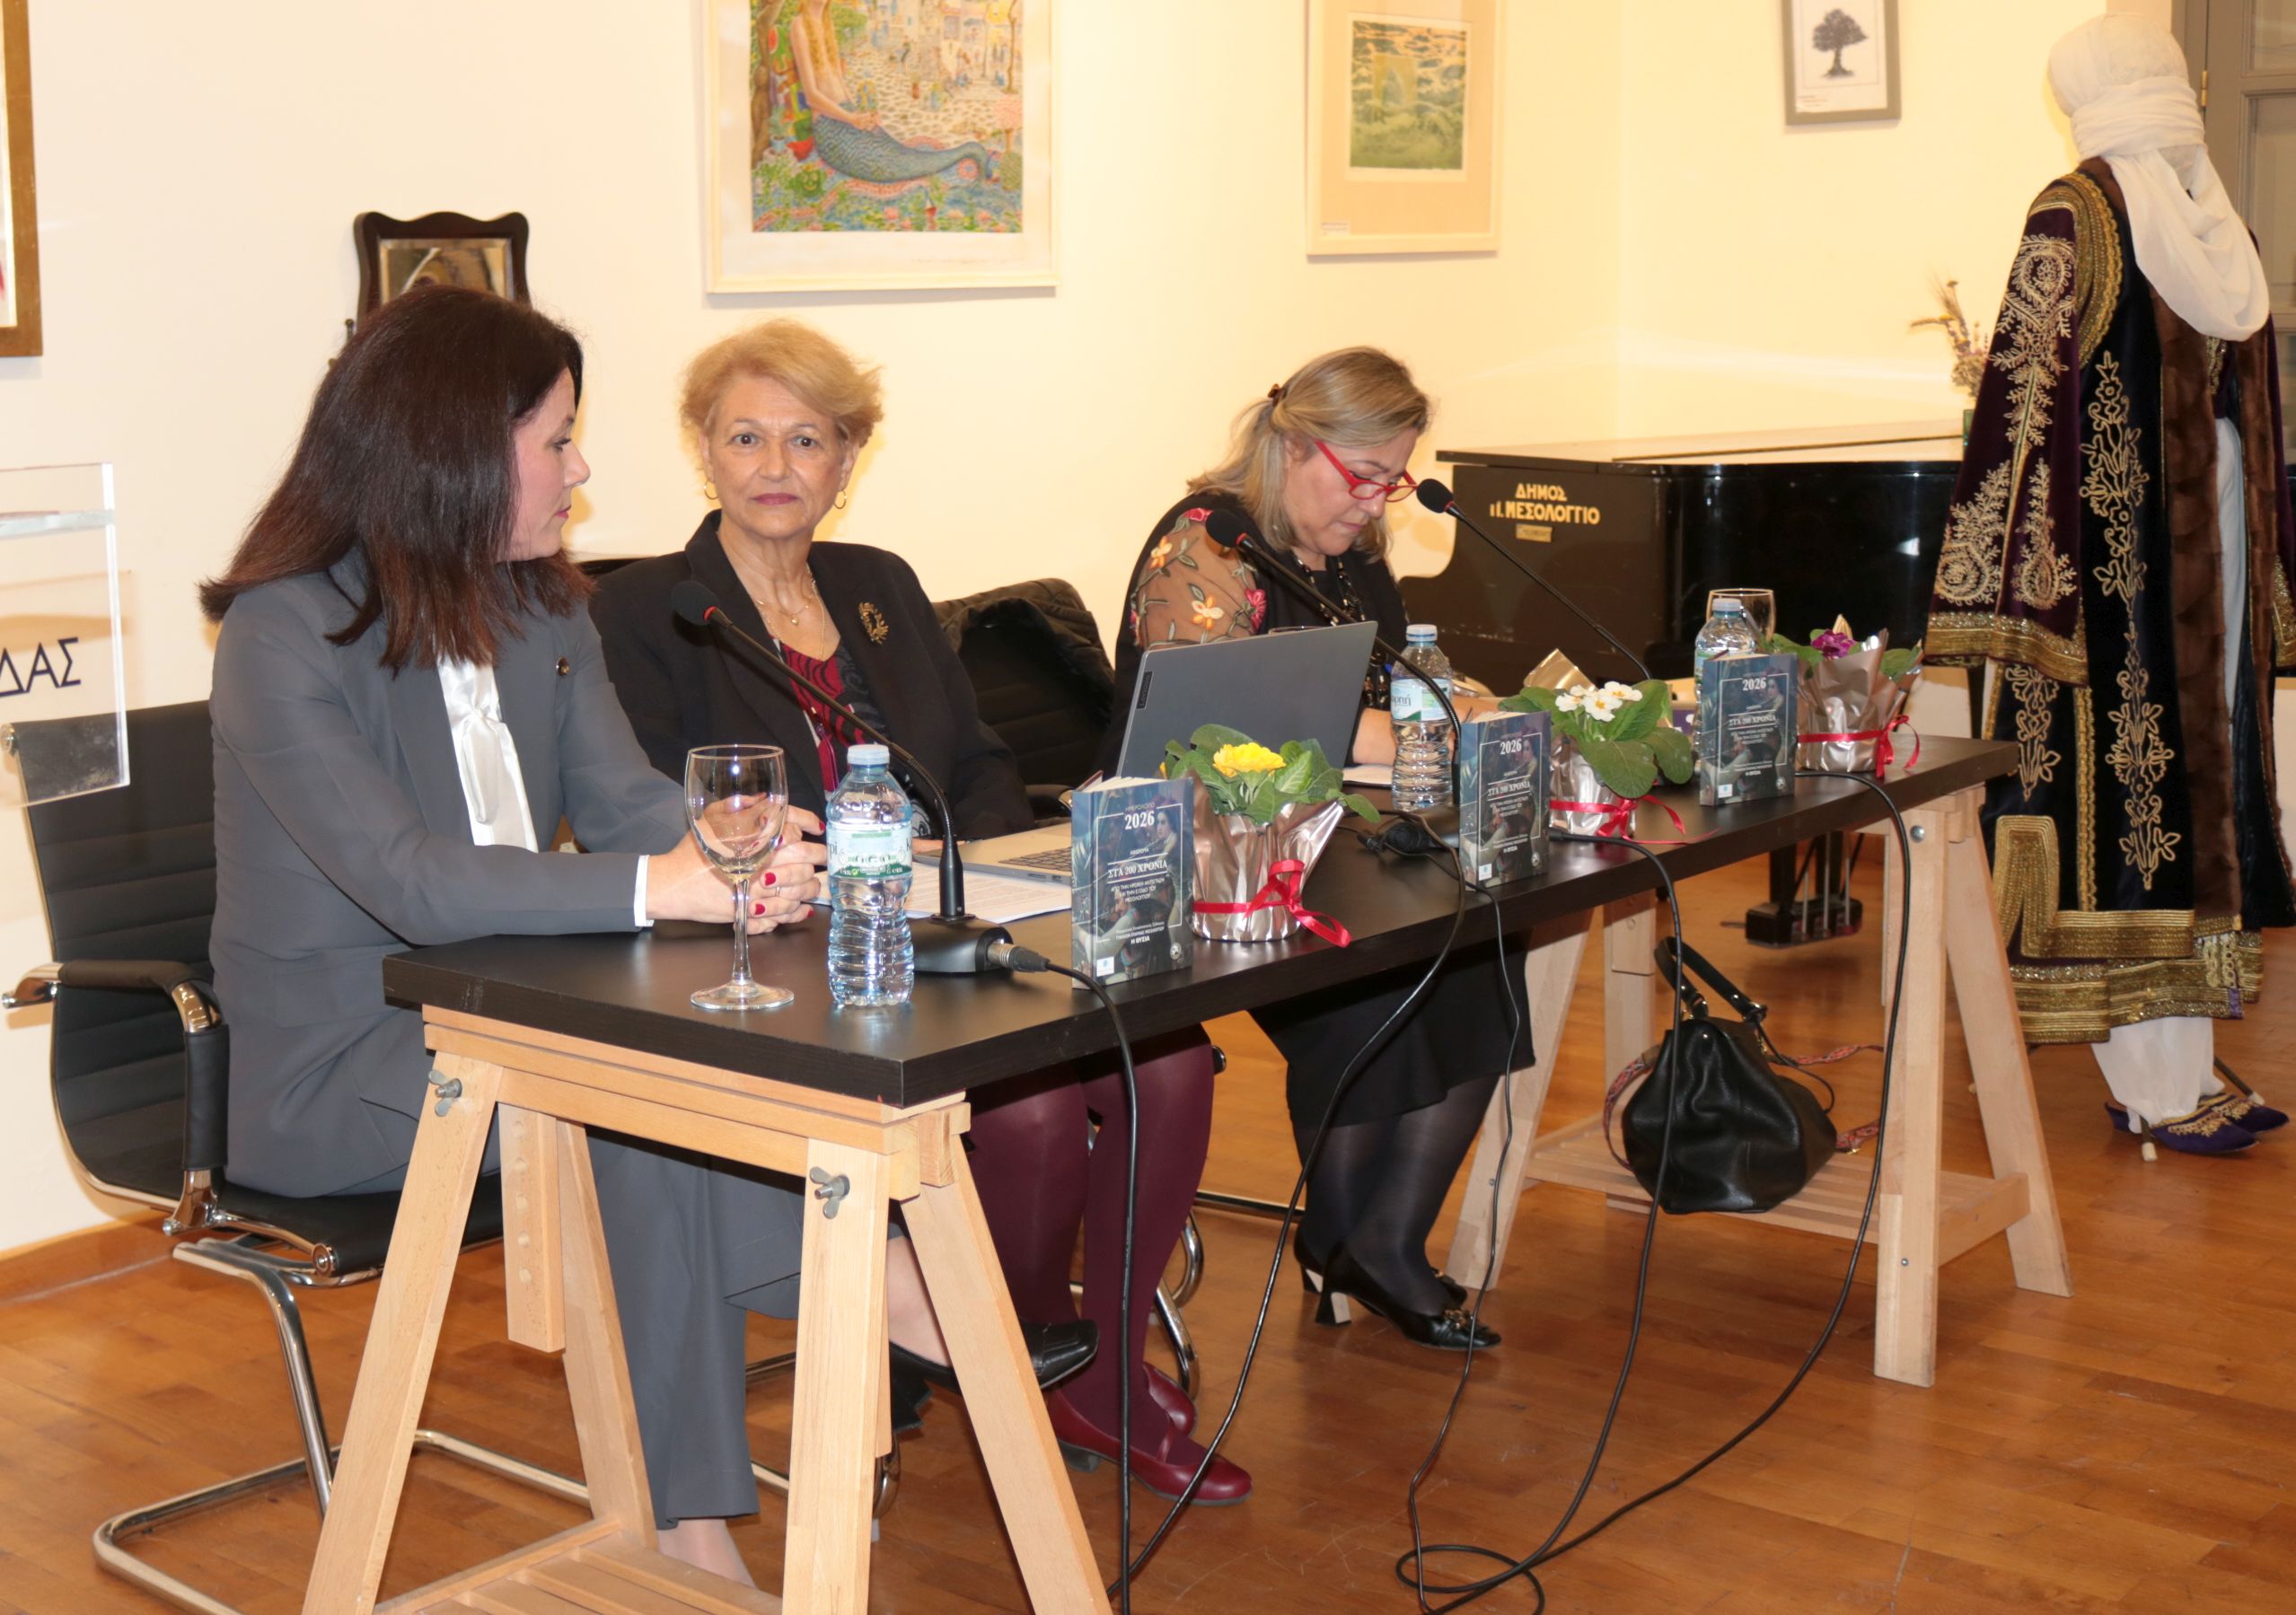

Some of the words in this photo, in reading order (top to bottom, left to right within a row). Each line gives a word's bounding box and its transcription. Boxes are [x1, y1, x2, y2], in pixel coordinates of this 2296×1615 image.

[1515, 483, 1568, 502] ΔΗΜΟΣ
[1742, 678, 1767, 691] 2026
[1500, 738, 1522, 755] 2026
[1124, 811, 1156, 830] 2026
[1107, 868, 1123, 879] ΣΤΑ
[1124, 864, 1137, 875] 200
[1138, 859, 1168, 873] ΧΡΟΝΙΑ
